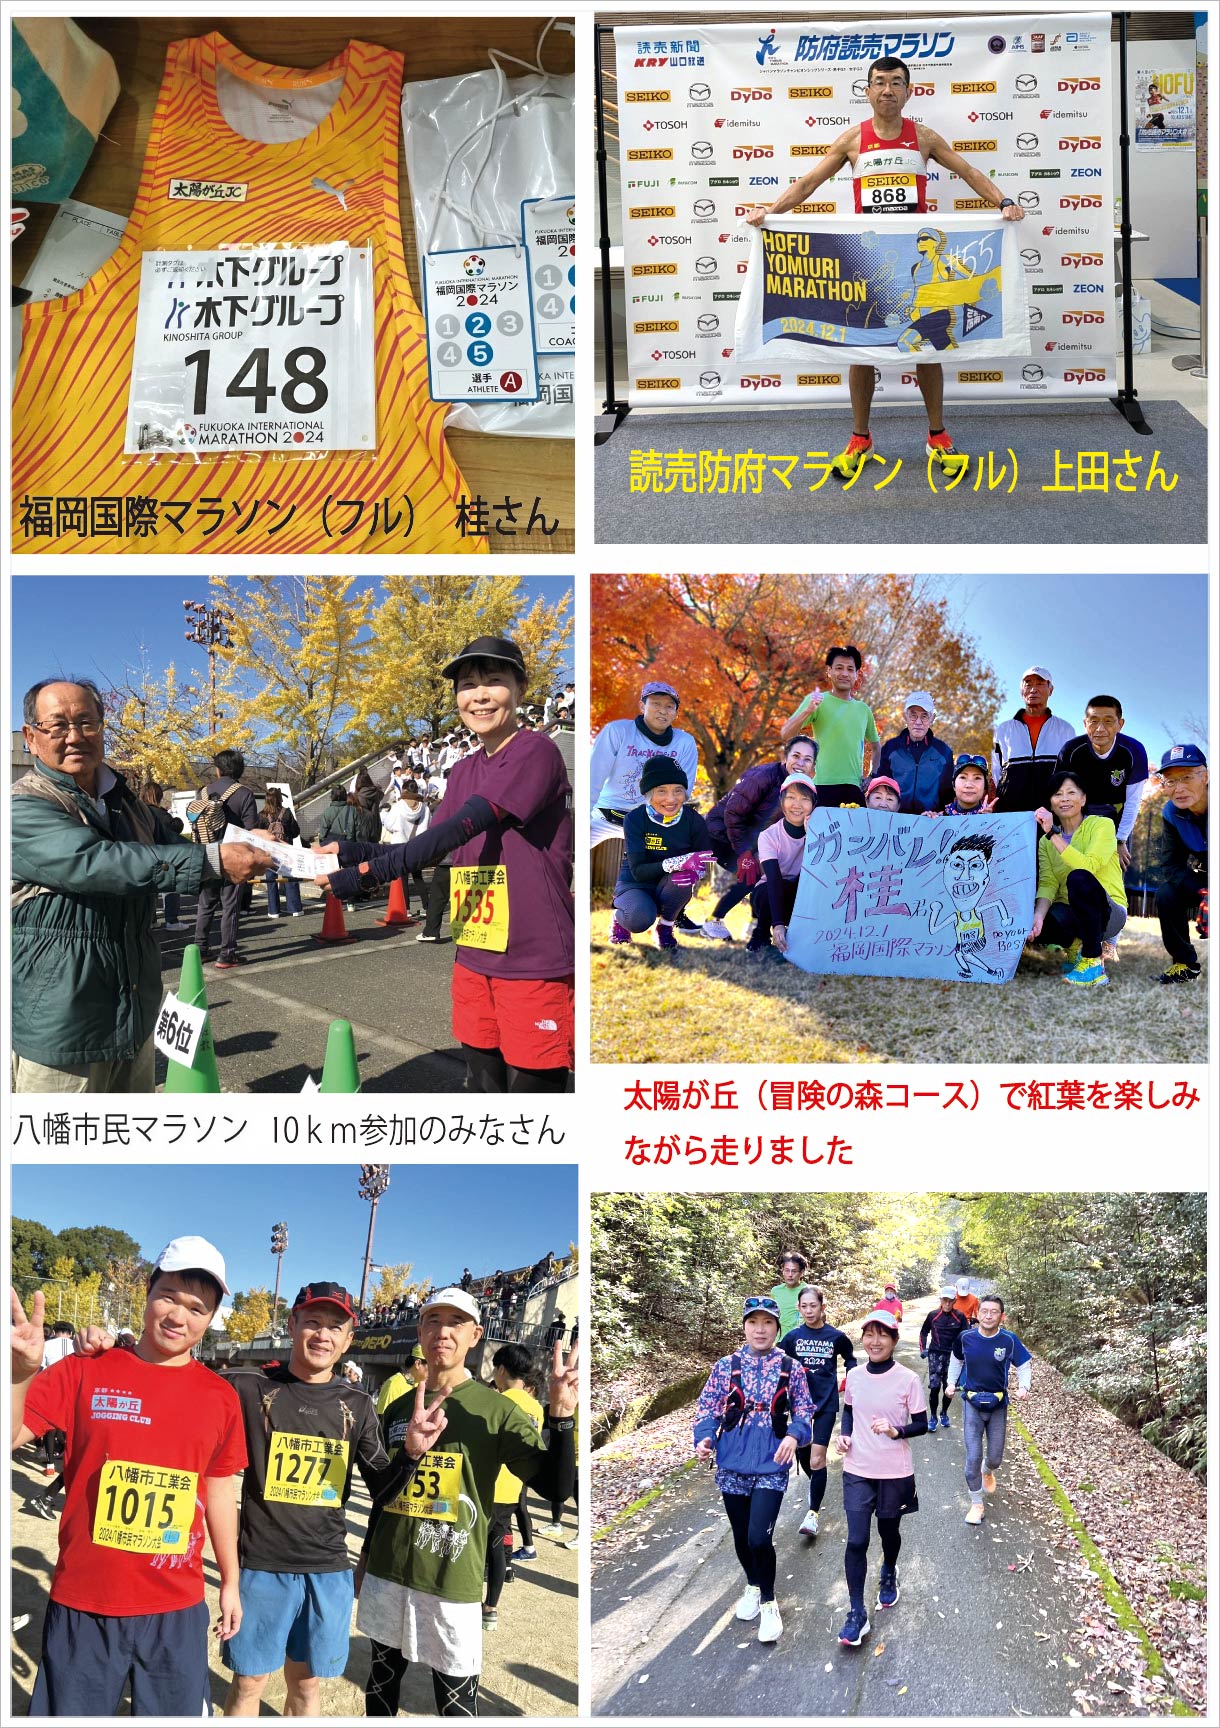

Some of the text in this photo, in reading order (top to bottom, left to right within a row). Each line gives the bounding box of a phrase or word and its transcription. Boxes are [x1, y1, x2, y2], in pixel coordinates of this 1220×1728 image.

[636, 39, 700, 55] 読売新聞
[794, 31, 956, 62] 防府読売マラソン
[634, 55, 705, 68] KRY 山口放送
[626, 91, 670, 102] SEIKO
[731, 88, 773, 104] DyDo
[790, 88, 832, 98] SEIKO
[952, 82, 996, 94] SEIKO
[1057, 78, 1101, 94] DyDo
[654, 120, 688, 130] TOSOH
[726, 118, 761, 128] idemitsu
[816, 116, 851, 126] TOSOH
[979, 111, 1014, 121] TOSOH
[1052, 110, 1088, 120] idemitsu
[628, 149, 672, 160] SEIKO
[732, 146, 774, 161] DyDo
[953, 141, 997, 151] SEIKO
[1058, 139, 1102, 152] DyDo
[749, 176, 779, 186] ZEON
[867, 175, 910, 188] SEIKO
[1070, 167, 1102, 177] ZEON
[172, 182, 242, 199] 太陽が丘JC
[637, 180, 660, 188] FUJI
[872, 187, 907, 204] 868
[631, 207, 674, 218] SEIKO
[1059, 198, 1103, 211] DyDo
[72, 216, 92, 228] PLACE
[659, 226, 1090, 245] TOSOH idemitsu
[763, 231, 811, 255] HOFU
[633, 264, 676, 275] SEIKO
[1061, 256, 1104, 269] DyDo
[766, 252, 841, 280] YOMIURI
[543, 269, 555, 287] 1
[766, 273, 868, 302] MARATHON
[436, 281, 519, 296] 福岡国際マラソン
[1073, 284, 1104, 293] ZEON
[543, 298, 559, 315] 4
[641, 294, 664, 303] FUJI
[193, 294, 345, 329] 木下グループ
[442, 314, 518, 336] 1 2 3
[635, 322, 678, 333] SEIKO
[1062, 314, 1105, 327] DyDo
[780, 317, 847, 343] 2024.12.1
[163, 331, 243, 342] KINOSHITA GROUP
[443, 344, 488, 363] 4 5
[663, 342, 1093, 360] TOSOH idemitsu
[184, 346, 329, 416] 148
[467, 373, 517, 393] ATHLETE A
[471, 372, 493, 384] 選手
[637, 379, 680, 389] SEIKO
[740, 377, 782, 391] DyDo
[798, 375, 840, 385] SEIKO
[959, 372, 1002, 382] SEIKO
[1064, 372, 1106, 385] DyDo
[199, 421, 324, 431] FUKUOKA INTERNATIONAL
[198, 432, 278, 445] MARATHON
[455, 869, 505, 886] 八幡市工業会
[453, 889, 495, 925] 1535
[814, 924, 889, 944] 2024.12.1
[831, 937, 960, 964] 福岡国際マラソン
[156, 1007, 194, 1055] 第6位
[795, 1345, 834, 1354] MARATHON
[796, 1338, 834, 1348] OKAYAMA
[803, 1356, 826, 1366] 2024
[93, 1395, 141, 1413] 太陽が丘
[91, 1411, 152, 1425] JOGGING CLUB
[276, 1436, 344, 1457] 八幡市工業会
[274, 1452, 332, 1486] 1277
[420, 1454, 456, 1470] 工業会
[109, 1464, 192, 1491] 八幡市工業会
[105, 1484, 176, 1530] 1015
[98, 1526, 163, 1549] 2024八幡市民マラソン大会
